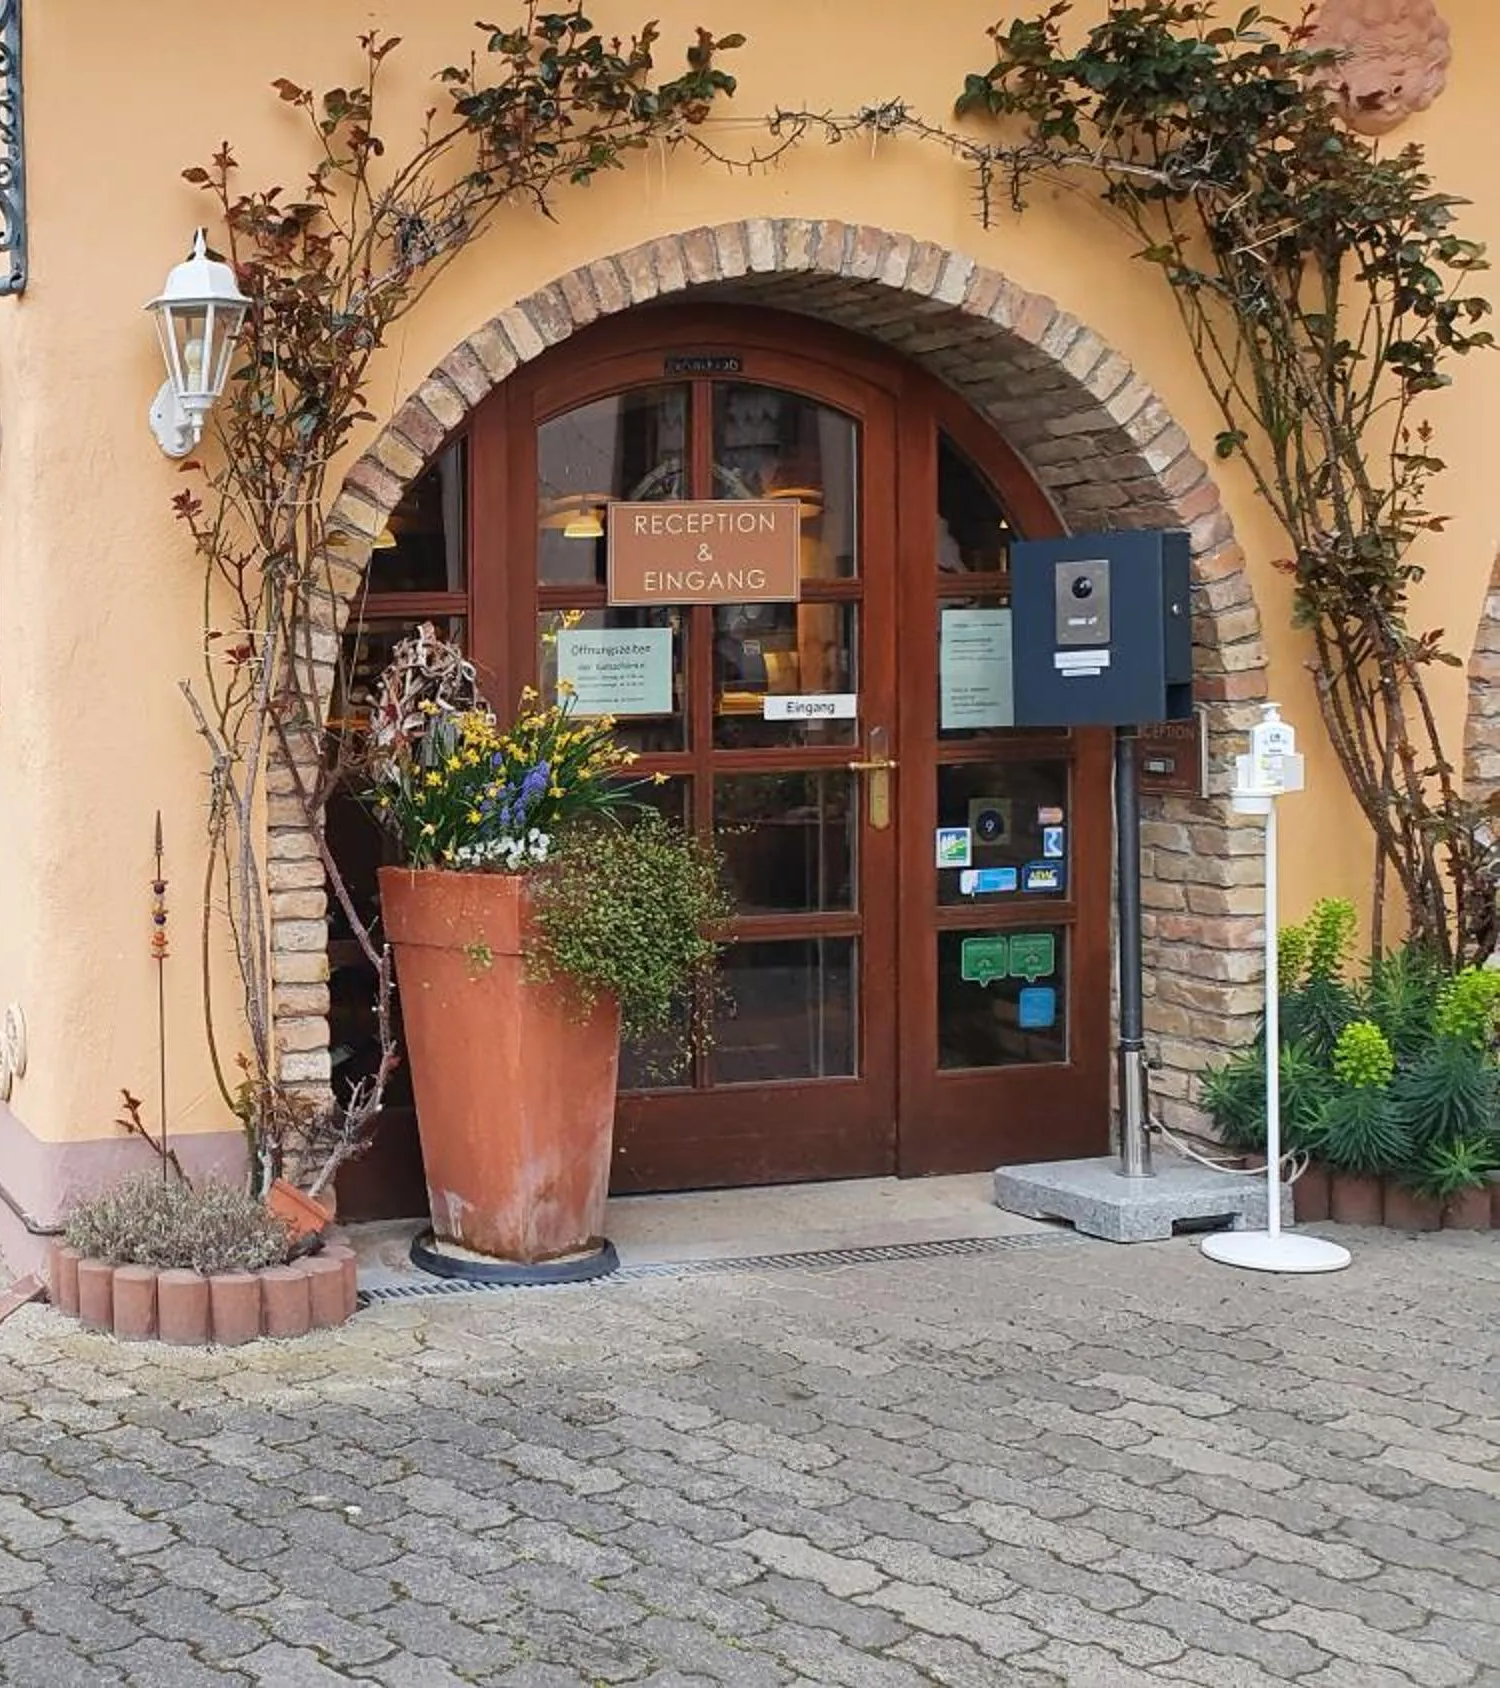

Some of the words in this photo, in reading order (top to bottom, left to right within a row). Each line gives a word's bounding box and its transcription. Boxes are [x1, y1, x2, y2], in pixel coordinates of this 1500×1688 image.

[634, 511, 776, 535] RECEPTION
[697, 543, 713, 562] &
[643, 569, 766, 592] EINGANG
[786, 701, 835, 716] Eingang
